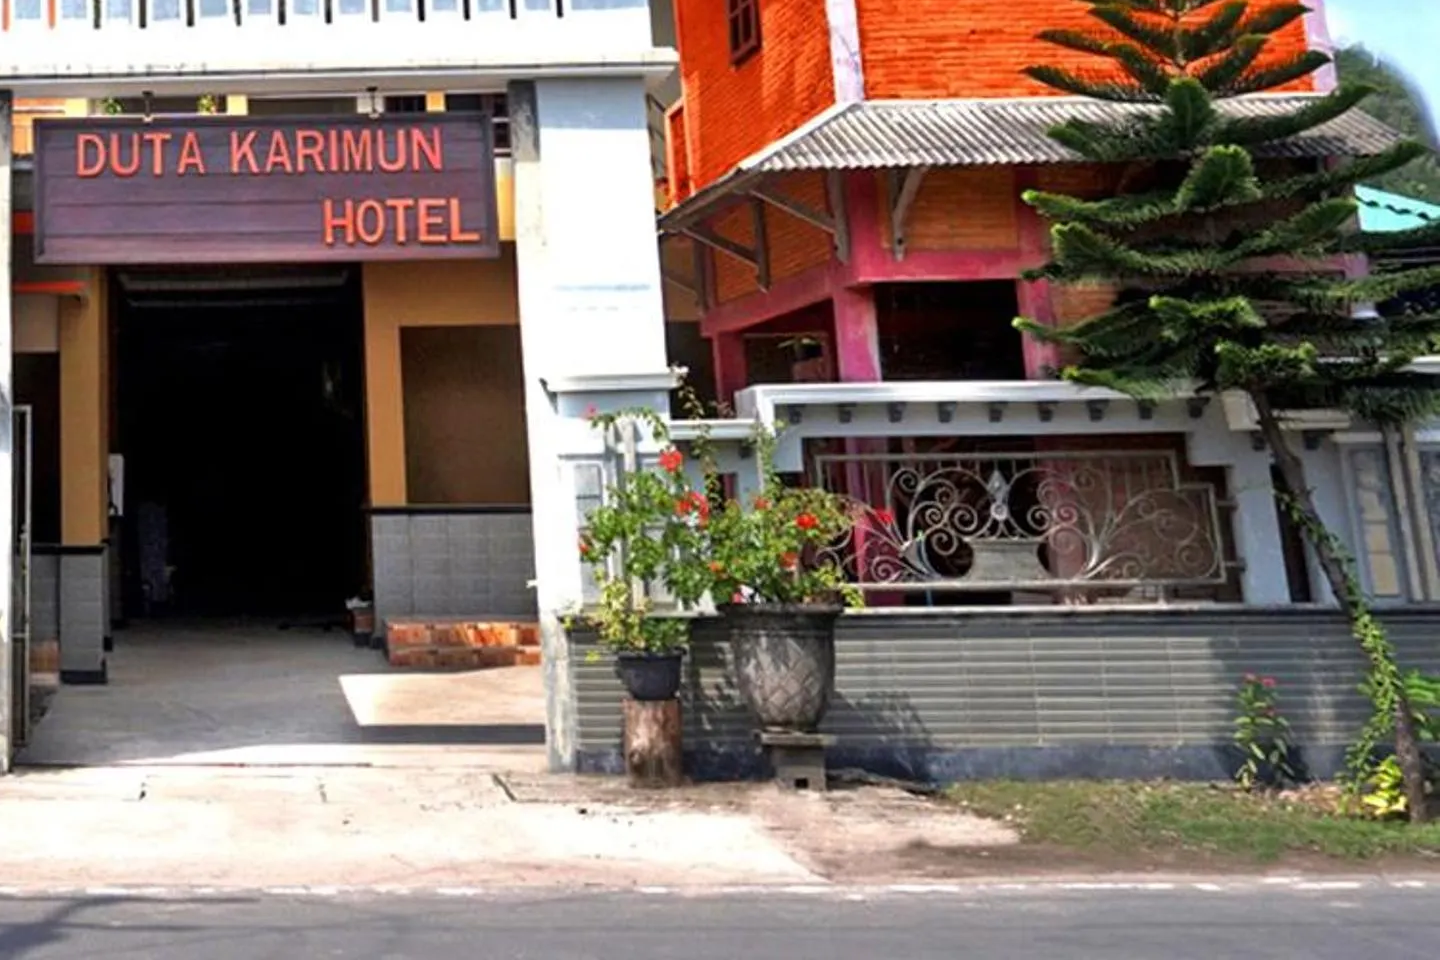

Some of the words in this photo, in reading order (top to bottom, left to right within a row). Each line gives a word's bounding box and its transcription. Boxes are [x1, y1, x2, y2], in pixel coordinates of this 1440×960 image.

[76, 131, 206, 178] DUTA
[230, 128, 443, 174] KARIMUN
[322, 197, 481, 245] HOTEL
